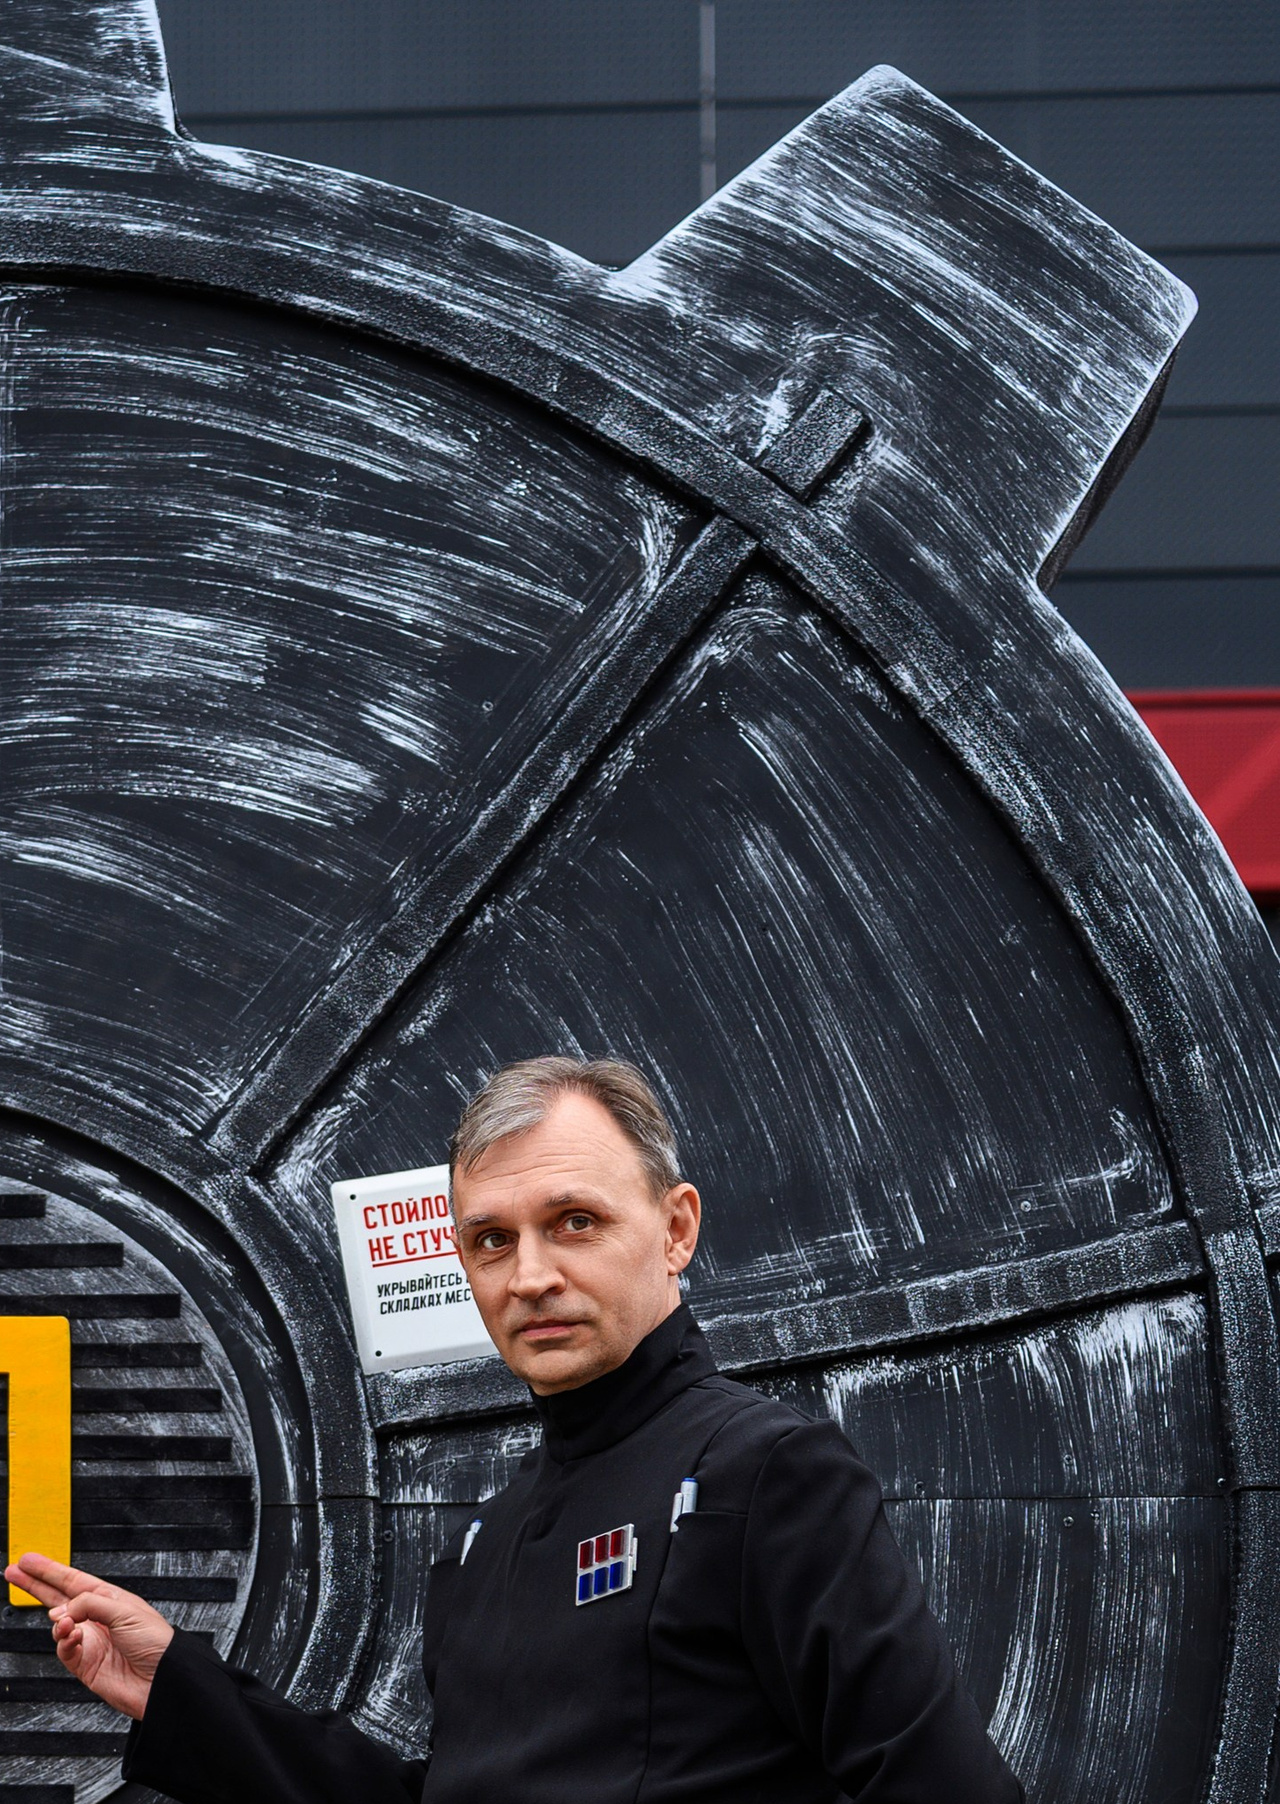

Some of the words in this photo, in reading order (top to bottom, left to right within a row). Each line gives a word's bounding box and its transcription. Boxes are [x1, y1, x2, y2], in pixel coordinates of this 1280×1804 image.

[368, 1235, 398, 1262] НЕ
[377, 1272, 462, 1298] УКРЫВАЙТЕСЬ
[380, 1292, 441, 1315] СКЛАДКАХ
